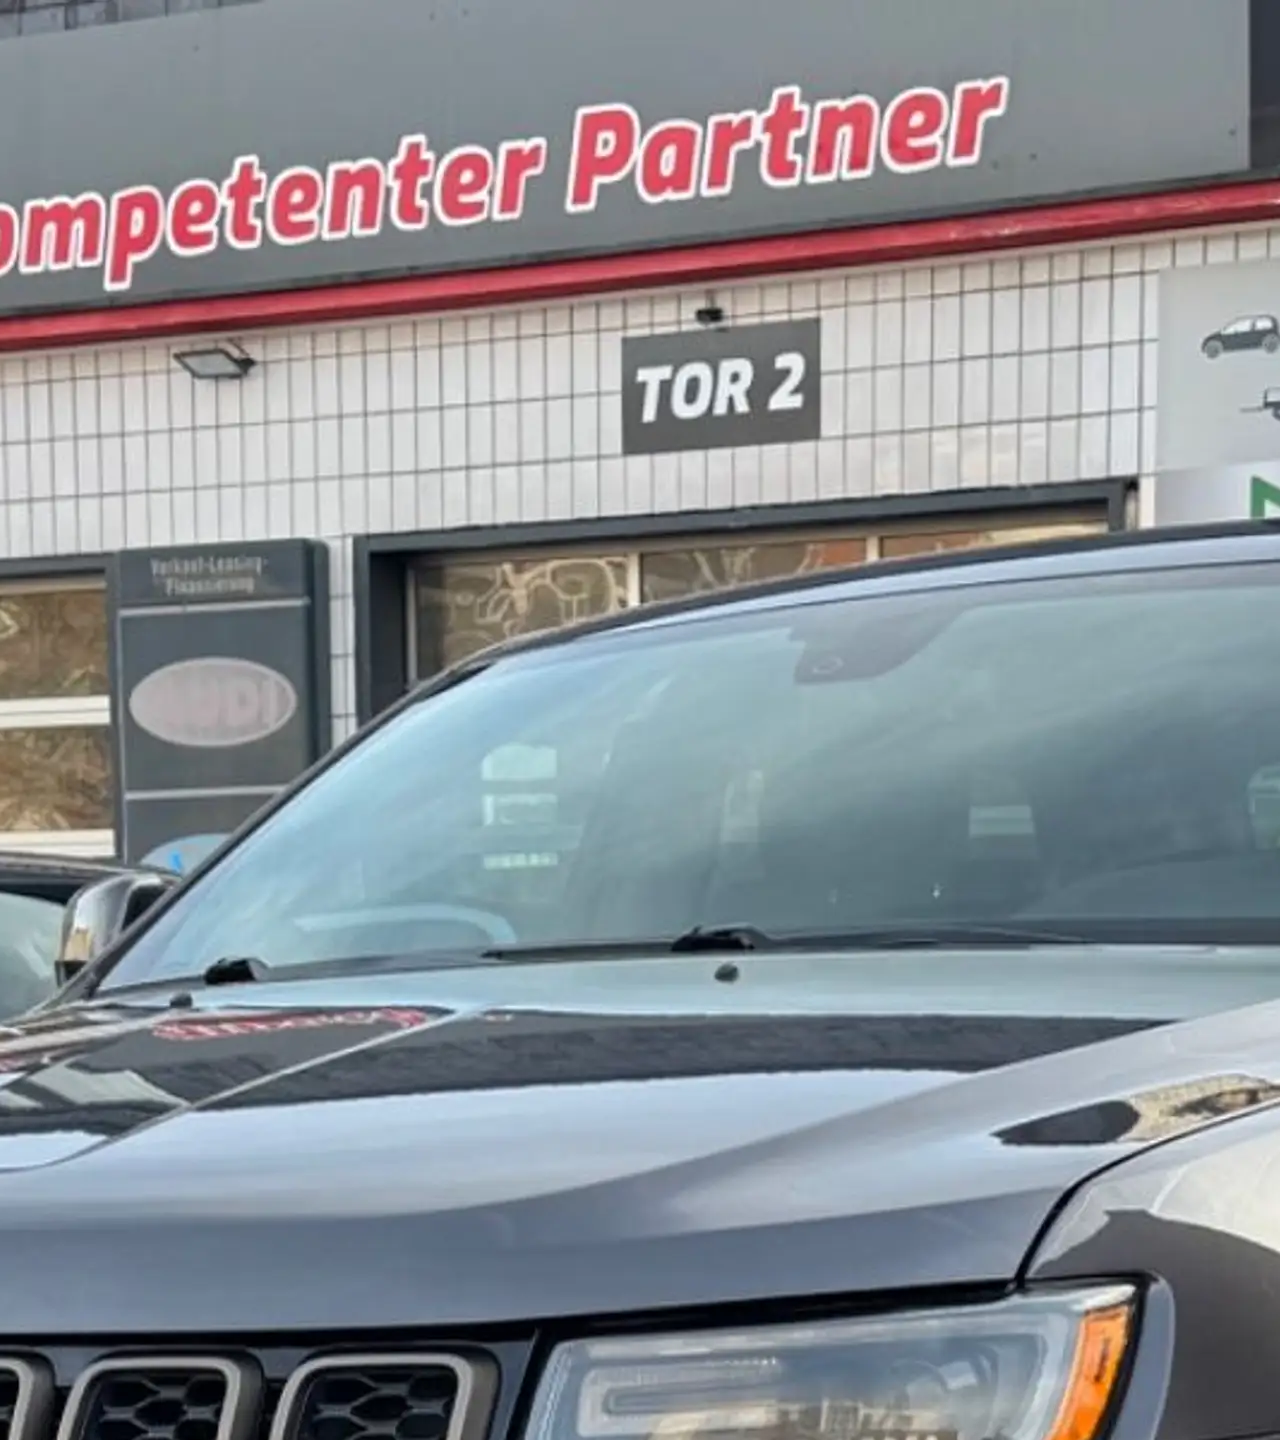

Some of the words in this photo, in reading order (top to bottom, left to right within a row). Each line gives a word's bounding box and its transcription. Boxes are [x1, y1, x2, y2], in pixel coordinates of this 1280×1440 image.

[565, 76, 1009, 212] Partner
[635, 356, 752, 424] TOR
[769, 353, 805, 412] 2
